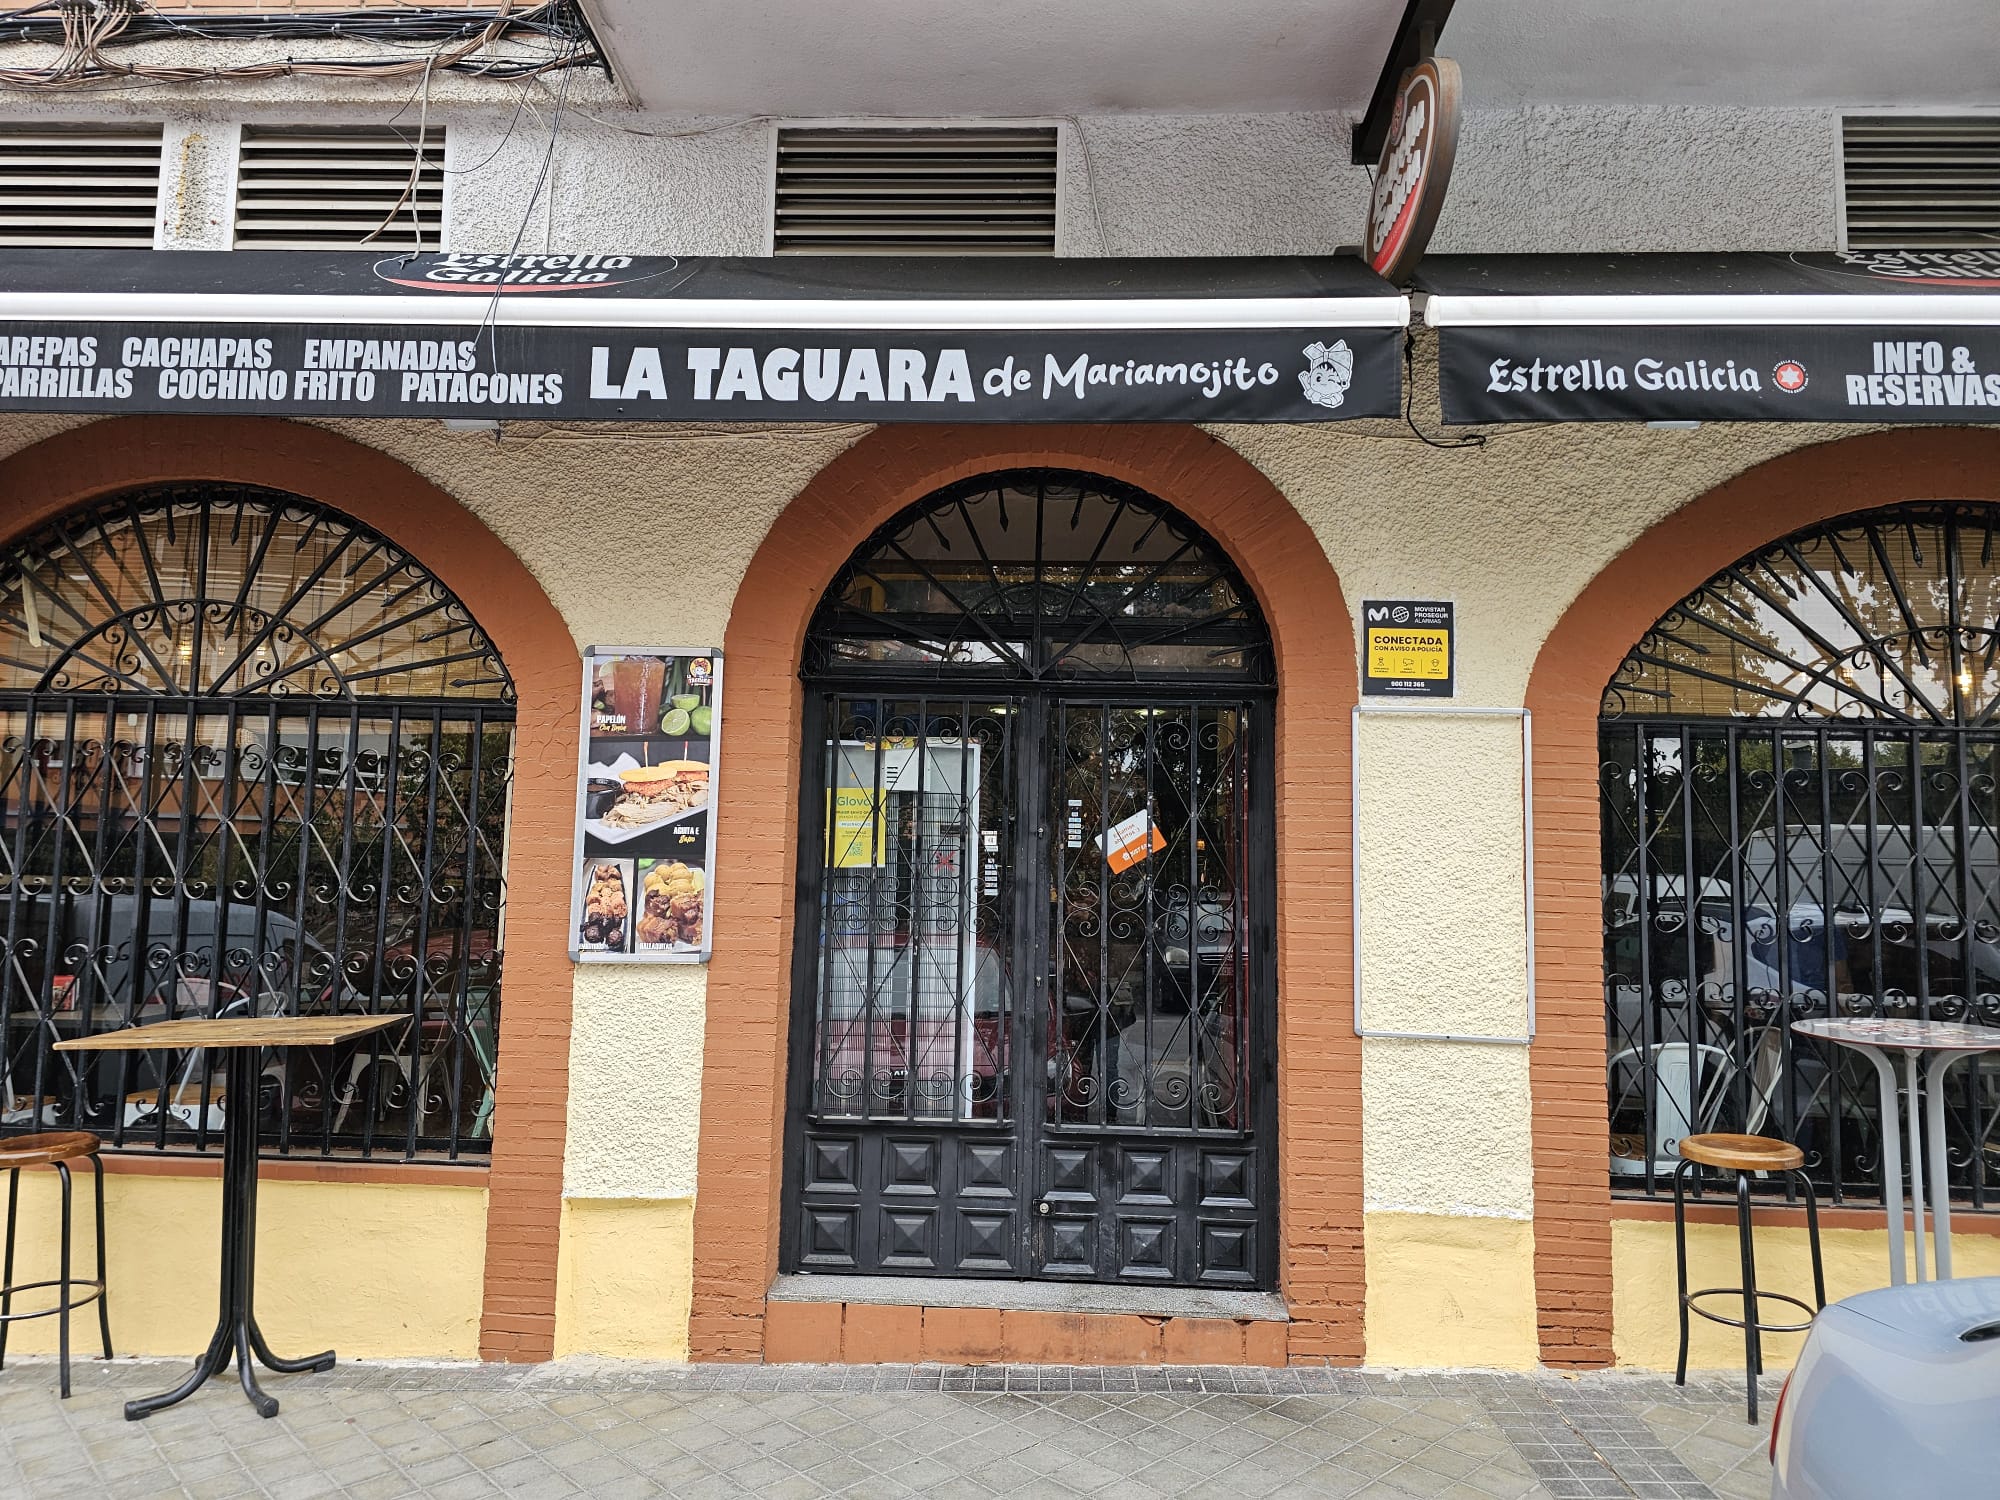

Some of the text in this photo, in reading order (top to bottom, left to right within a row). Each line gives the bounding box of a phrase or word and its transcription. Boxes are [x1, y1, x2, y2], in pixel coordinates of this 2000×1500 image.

[432, 253, 632, 269] Estrella
[425, 267, 609, 283] Galicia
[121, 337, 272, 369] CACHAPAS
[304, 338, 477, 371] EMPANADAS
[1873, 341, 1976, 374] INFO &
[589, 346, 1279, 402] LA TAGUARA de Mariamojito
[1486, 357, 1629, 393] Estrella
[1634, 358, 1763, 392] Galicia
[158, 369, 287, 401] COCHINO
[294, 371, 376, 402] FRITO
[401, 372, 563, 404] PATACONES
[1845, 374, 2000, 407] RESERVAS
[1374, 635, 1443, 646] CONECTADA
[1417, 645, 1443, 653] POLICÍA
[596, 713, 626, 724] PAPELÓN
[695, 826, 700, 835] E
